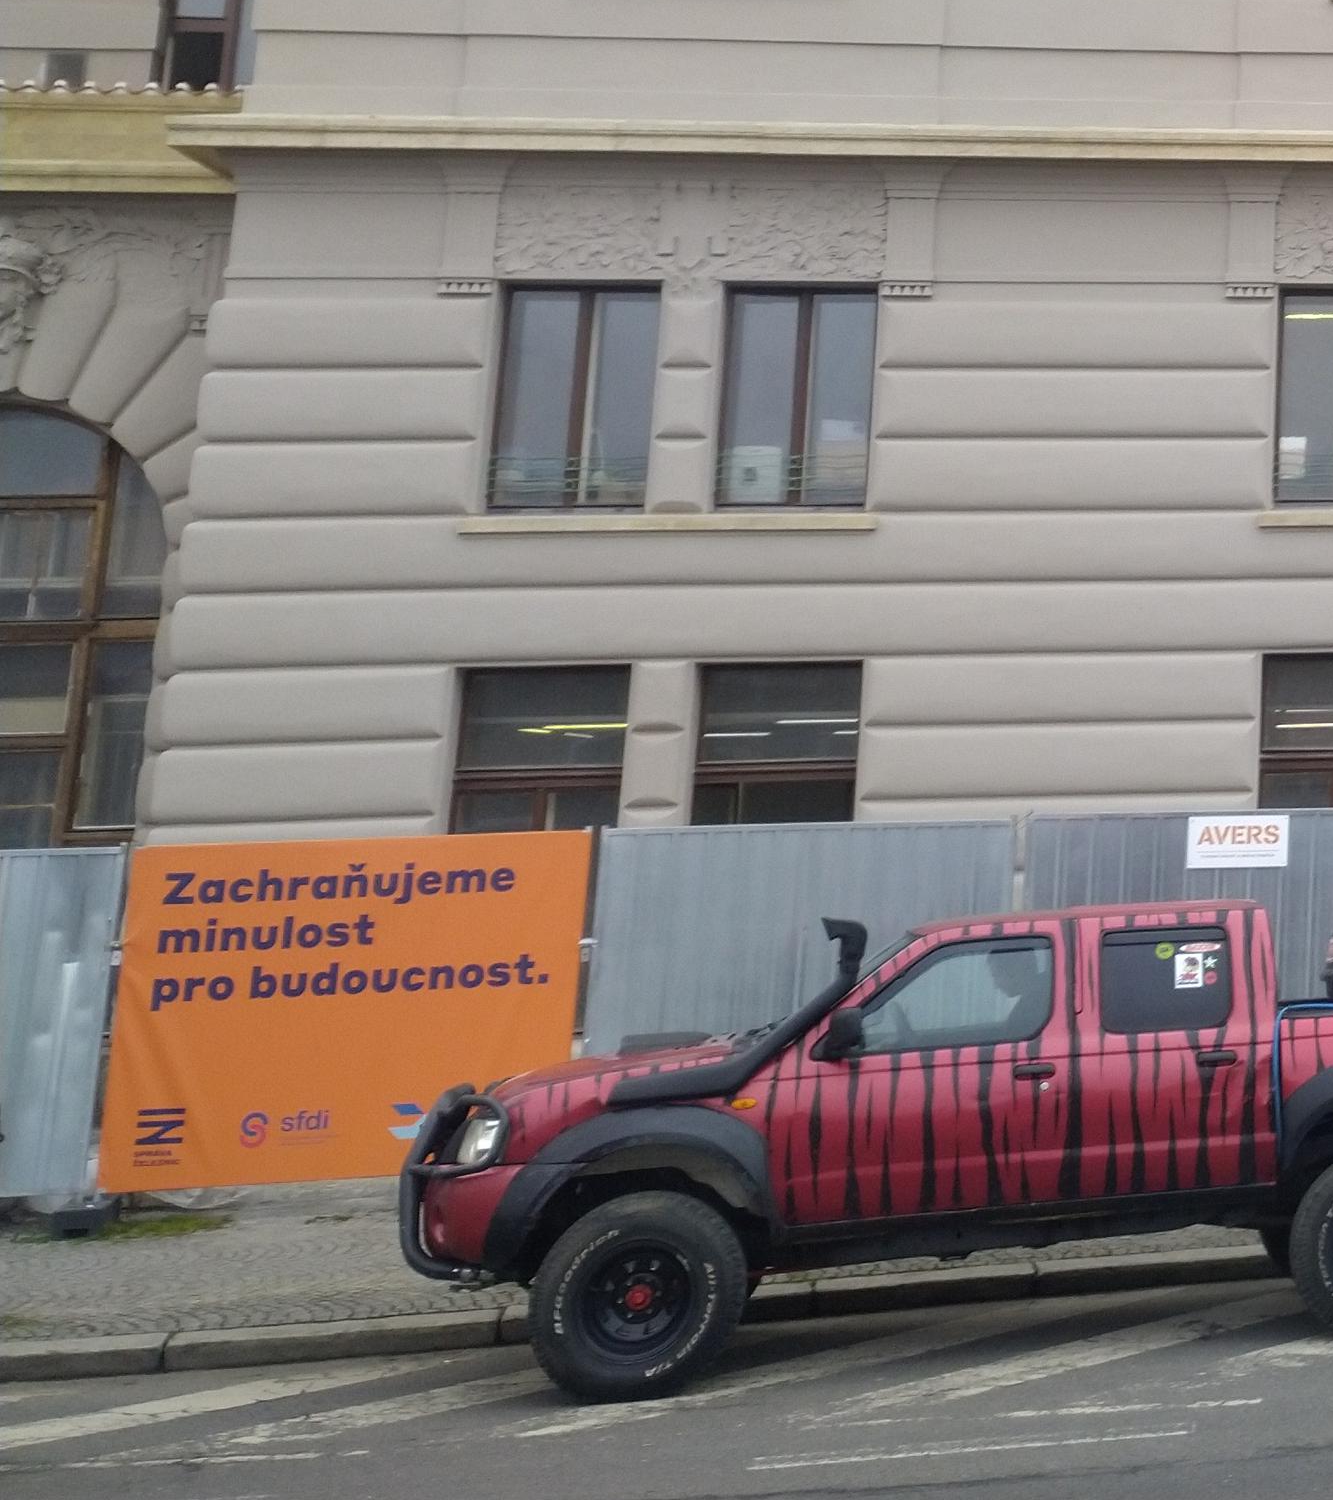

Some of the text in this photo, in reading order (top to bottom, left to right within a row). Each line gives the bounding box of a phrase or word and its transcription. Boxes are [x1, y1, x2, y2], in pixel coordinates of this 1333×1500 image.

[1197, 824, 1280, 845] AVERS
[162, 863, 516, 905] Zachraňujeme
[156, 914, 375, 954] minulost
[150, 953, 550, 1012] pro budoucnost.
[281, 1109, 329, 1132] sfdi
